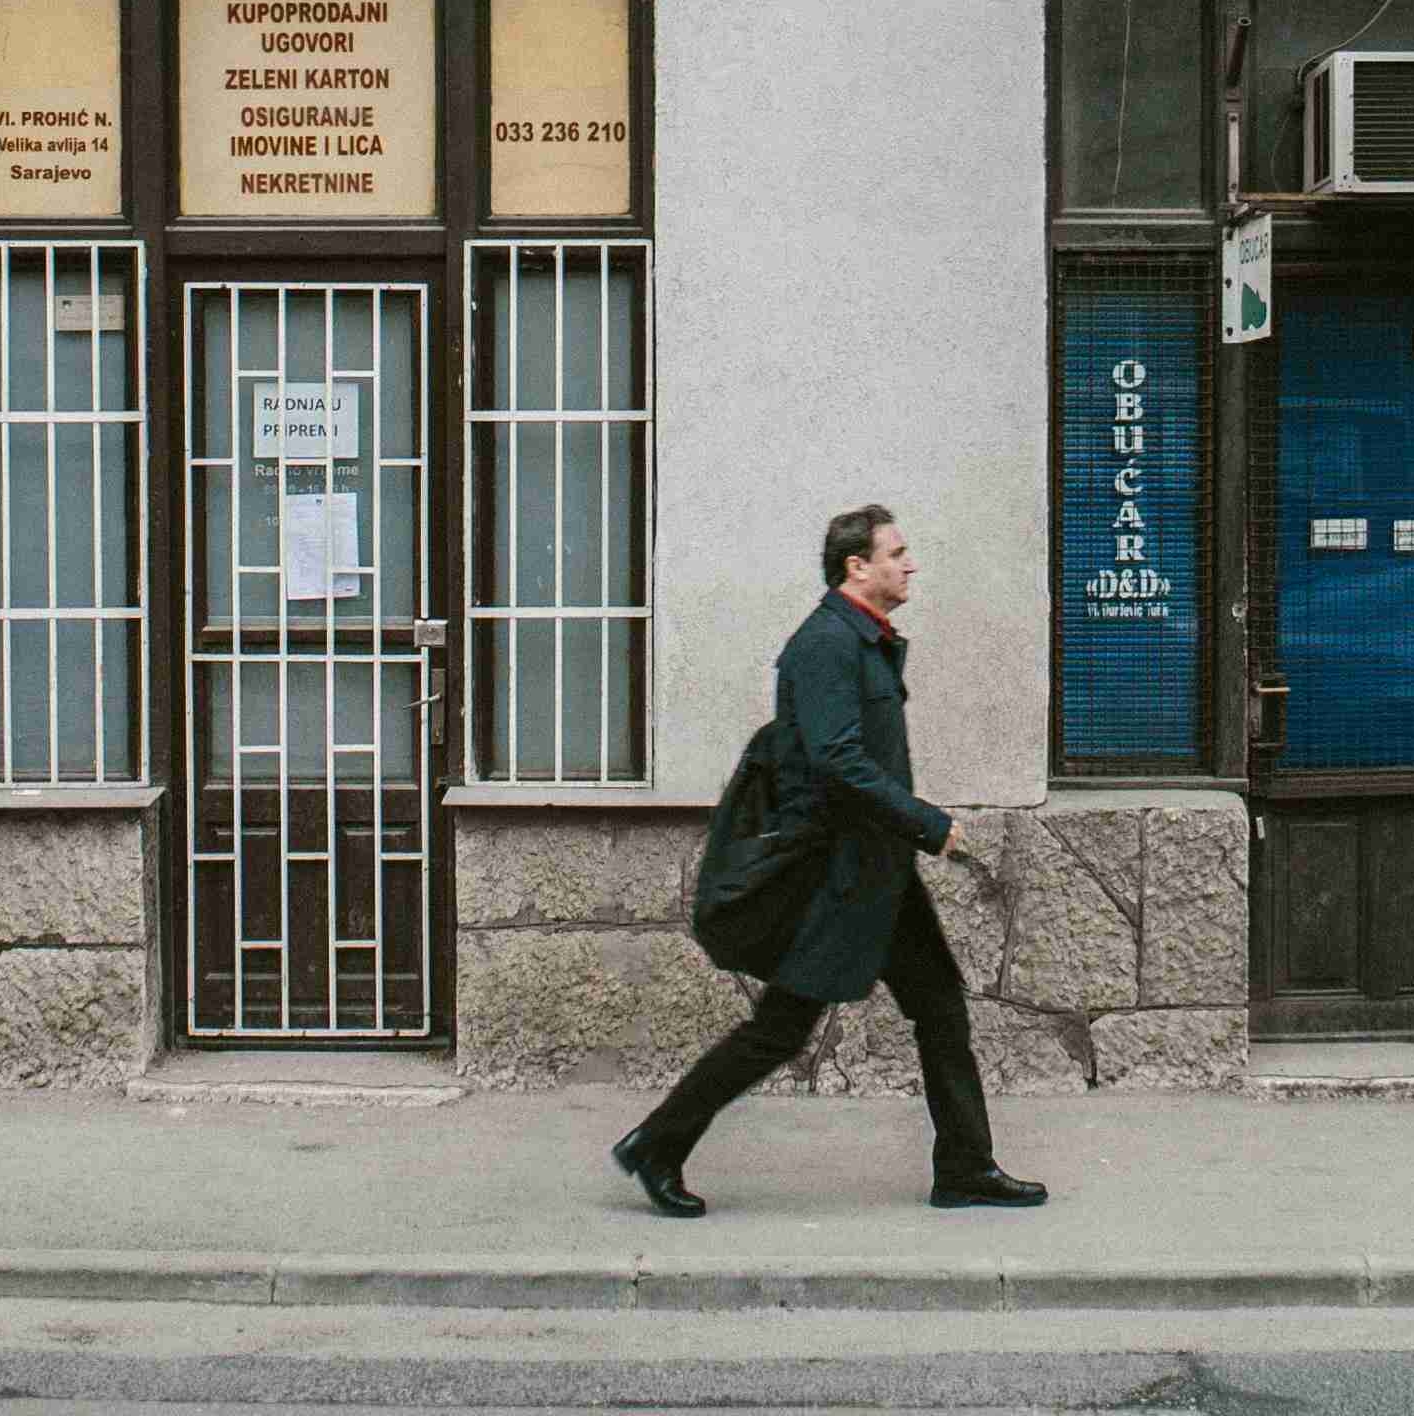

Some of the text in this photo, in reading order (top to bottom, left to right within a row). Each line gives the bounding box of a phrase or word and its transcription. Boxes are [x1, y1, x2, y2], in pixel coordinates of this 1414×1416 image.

[227, 1, 388, 24] KUPOPRODAJNI
[261, 31, 354, 54] UGOVORI
[225, 68, 389, 90] ZELENI KARTON
[21, 108, 89, 127] PROHIĆ
[94, 112, 112, 127] N.
[240, 106, 374, 128] OSIGURANJE
[495, 121, 626, 143] 033 236 210
[47, 137, 86, 156] avlija
[91, 137, 109, 153] 14
[230, 134, 383, 157] IMOVINE I LICA
[10, 164, 92, 184] Sarajevo
[240, 172, 373, 194] NEKRETNINE
